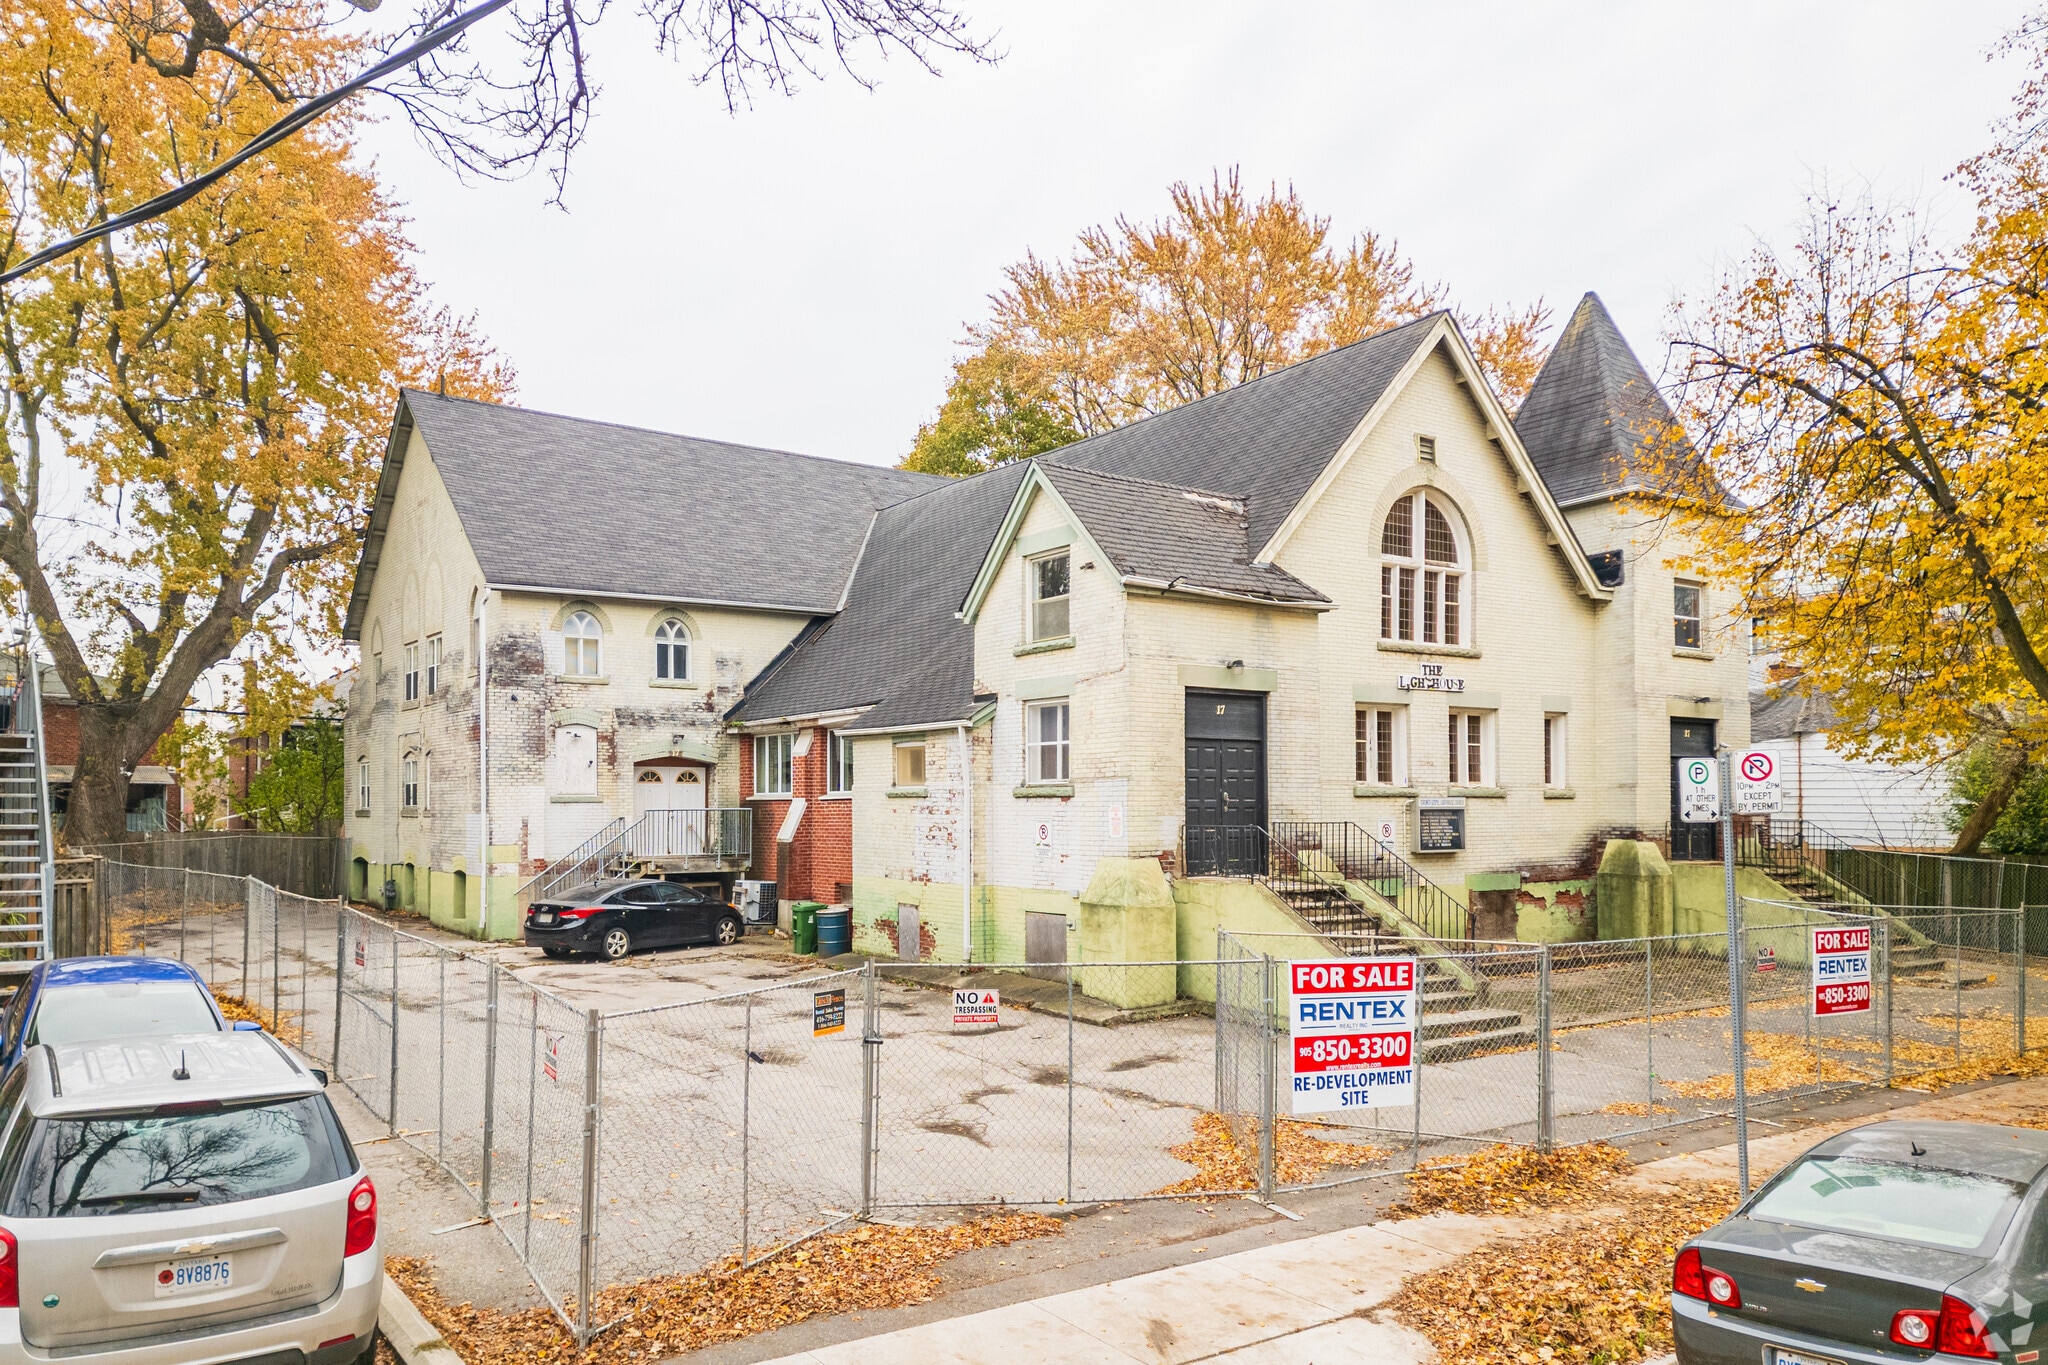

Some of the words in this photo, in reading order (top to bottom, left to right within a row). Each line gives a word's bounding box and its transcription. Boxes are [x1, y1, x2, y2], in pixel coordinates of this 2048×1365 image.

[1421, 664, 1443, 676] THE
[1216, 704, 1226, 715] 17
[1694, 767, 1704, 779] P
[1685, 794, 1693, 802] AT
[1697, 794, 1716, 802] OTHER
[1743, 791, 1772, 800] EXCEPT
[1692, 803, 1710, 812] TIMES
[1738, 802, 1748, 811] BY
[1752, 801, 1779, 810] PERMIT
[1817, 932, 1841, 950] FOR
[1843, 931, 1868, 949] SALE
[1819, 957, 1867, 975] RENTEX
[1296, 966, 1345, 989] FOR
[1352, 965, 1409, 988] SALE
[956, 992, 978, 1004] NO
[1825, 985, 1869, 1004] 850-3300
[955, 1005, 997, 1014] TRESPASSING
[1299, 999, 1406, 1022] RENTEX
[1299, 1047, 1312, 1057] 905
[1312, 1036, 1407, 1062] 850-3300
[1294, 1069, 1413, 1091] RE-DEVELOPMENT
[1341, 1090, 1369, 1106] SITE
[176, 1261, 229, 1285] 8V8876
